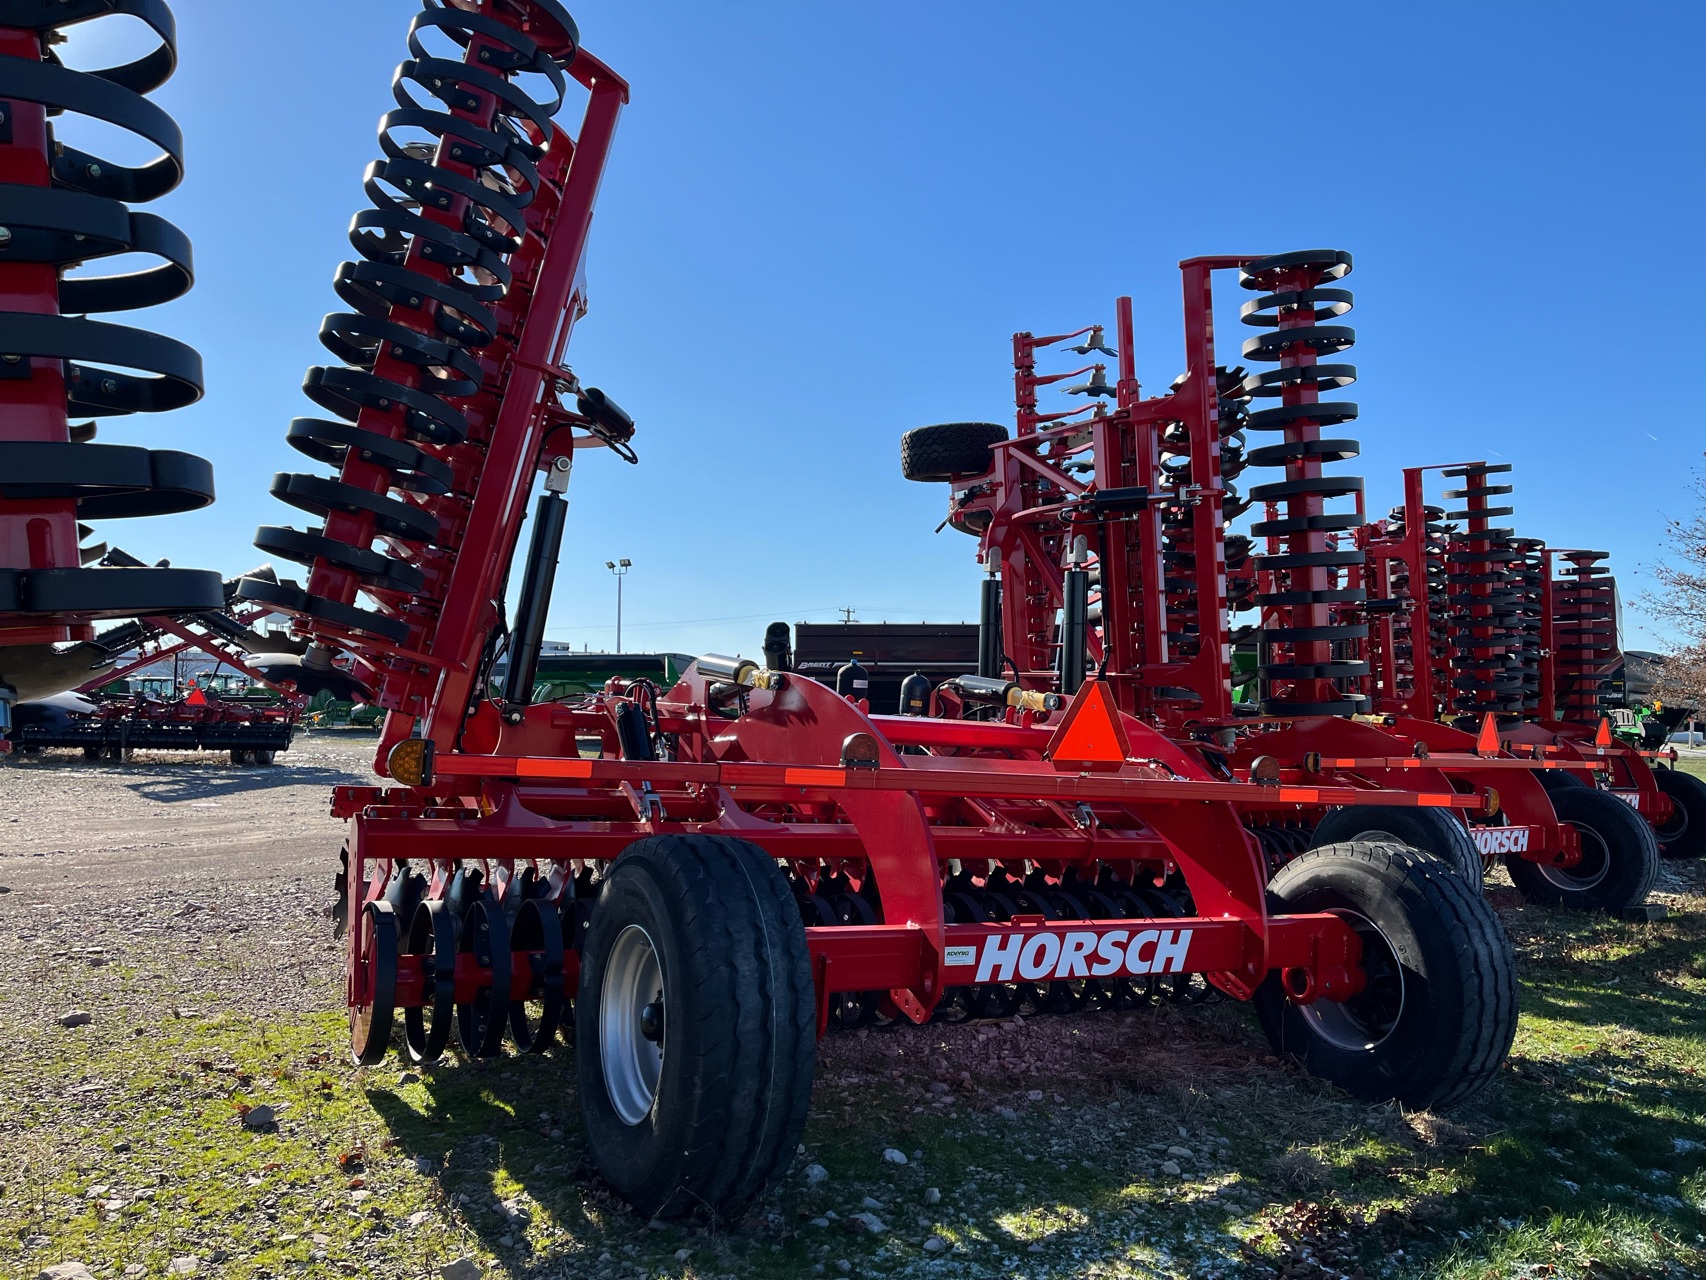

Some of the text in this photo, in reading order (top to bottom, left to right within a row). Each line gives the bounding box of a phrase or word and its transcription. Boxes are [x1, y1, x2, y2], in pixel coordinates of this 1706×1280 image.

[797, 661, 832, 670] BRENT
[1471, 830, 1530, 855] HORSCH
[974, 929, 1194, 983] HORSCH
